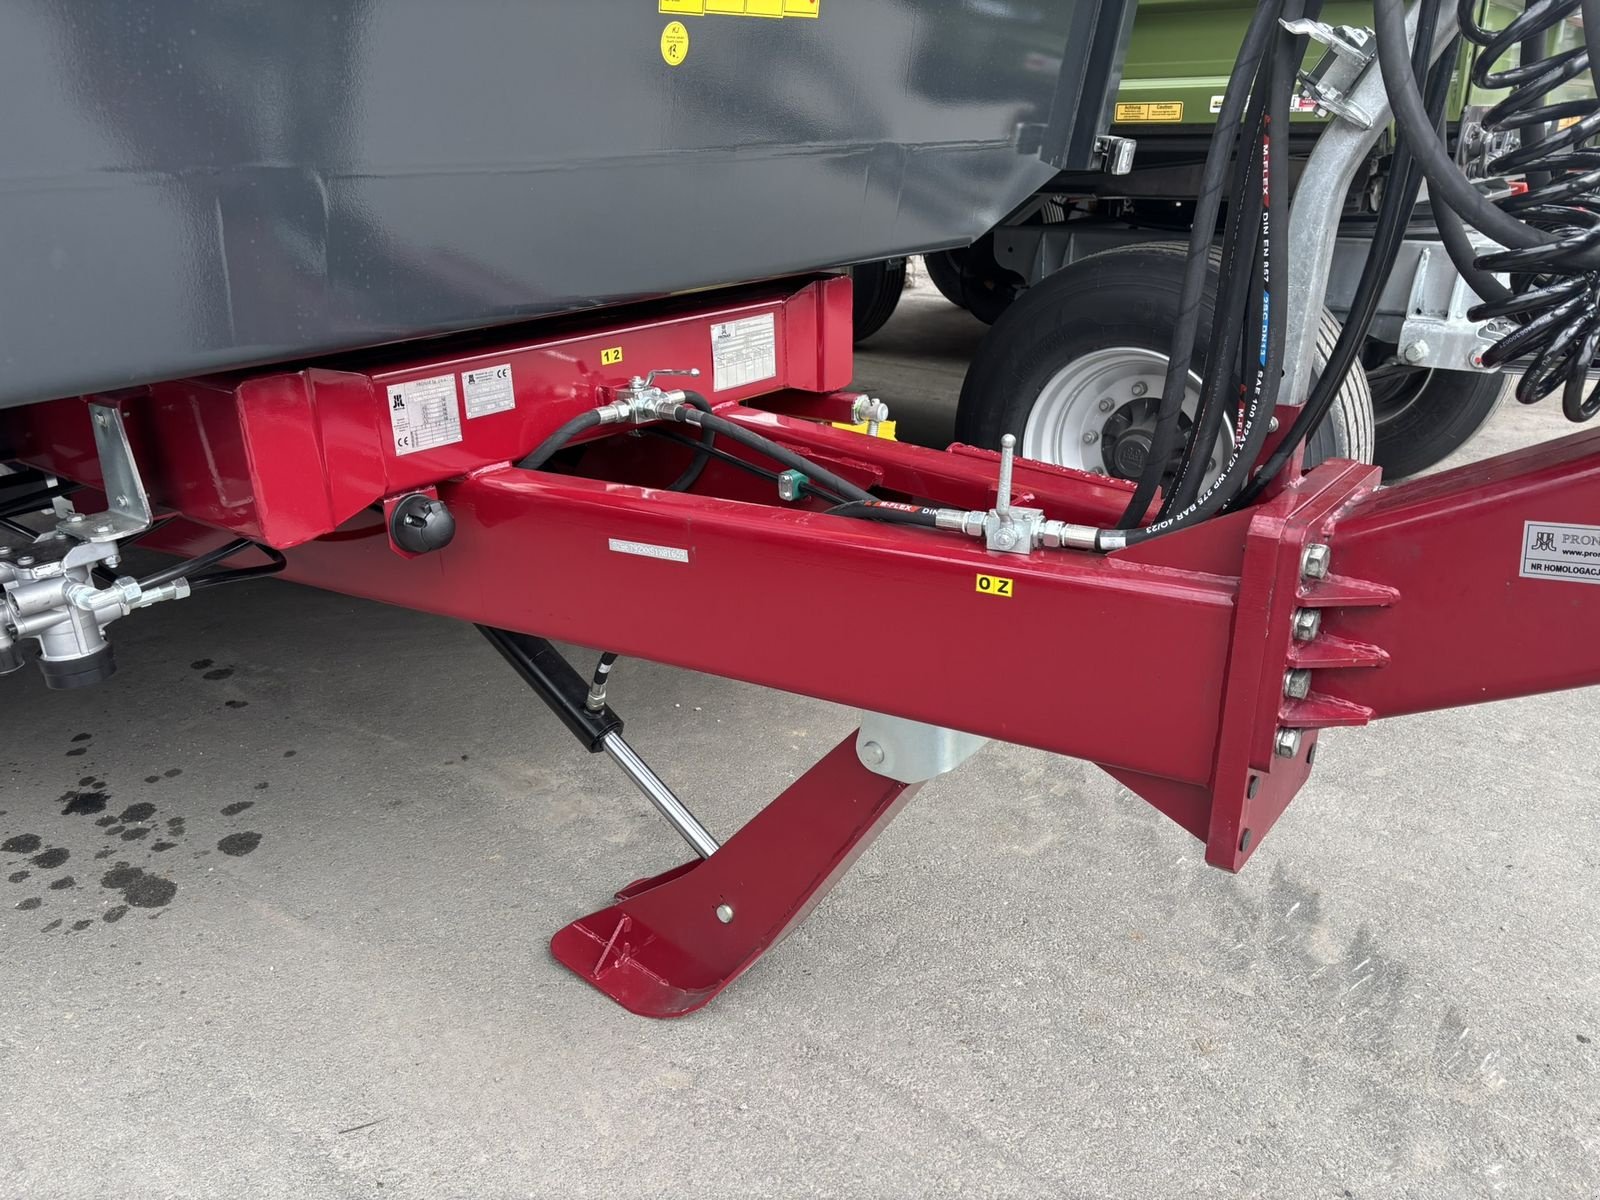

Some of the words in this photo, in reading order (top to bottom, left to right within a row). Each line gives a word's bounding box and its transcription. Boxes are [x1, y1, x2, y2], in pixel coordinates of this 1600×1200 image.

[1263, 239, 1270, 257] EN
[1254, 370, 1264, 395] SAE
[1249, 398, 1258, 418] 100
[1213, 473, 1227, 489] WP
[1197, 489, 1213, 506] 275
[879, 501, 913, 512] M-FLEX
[1176, 503, 1197, 521] BAR
[1530, 562, 1542, 571] NR
